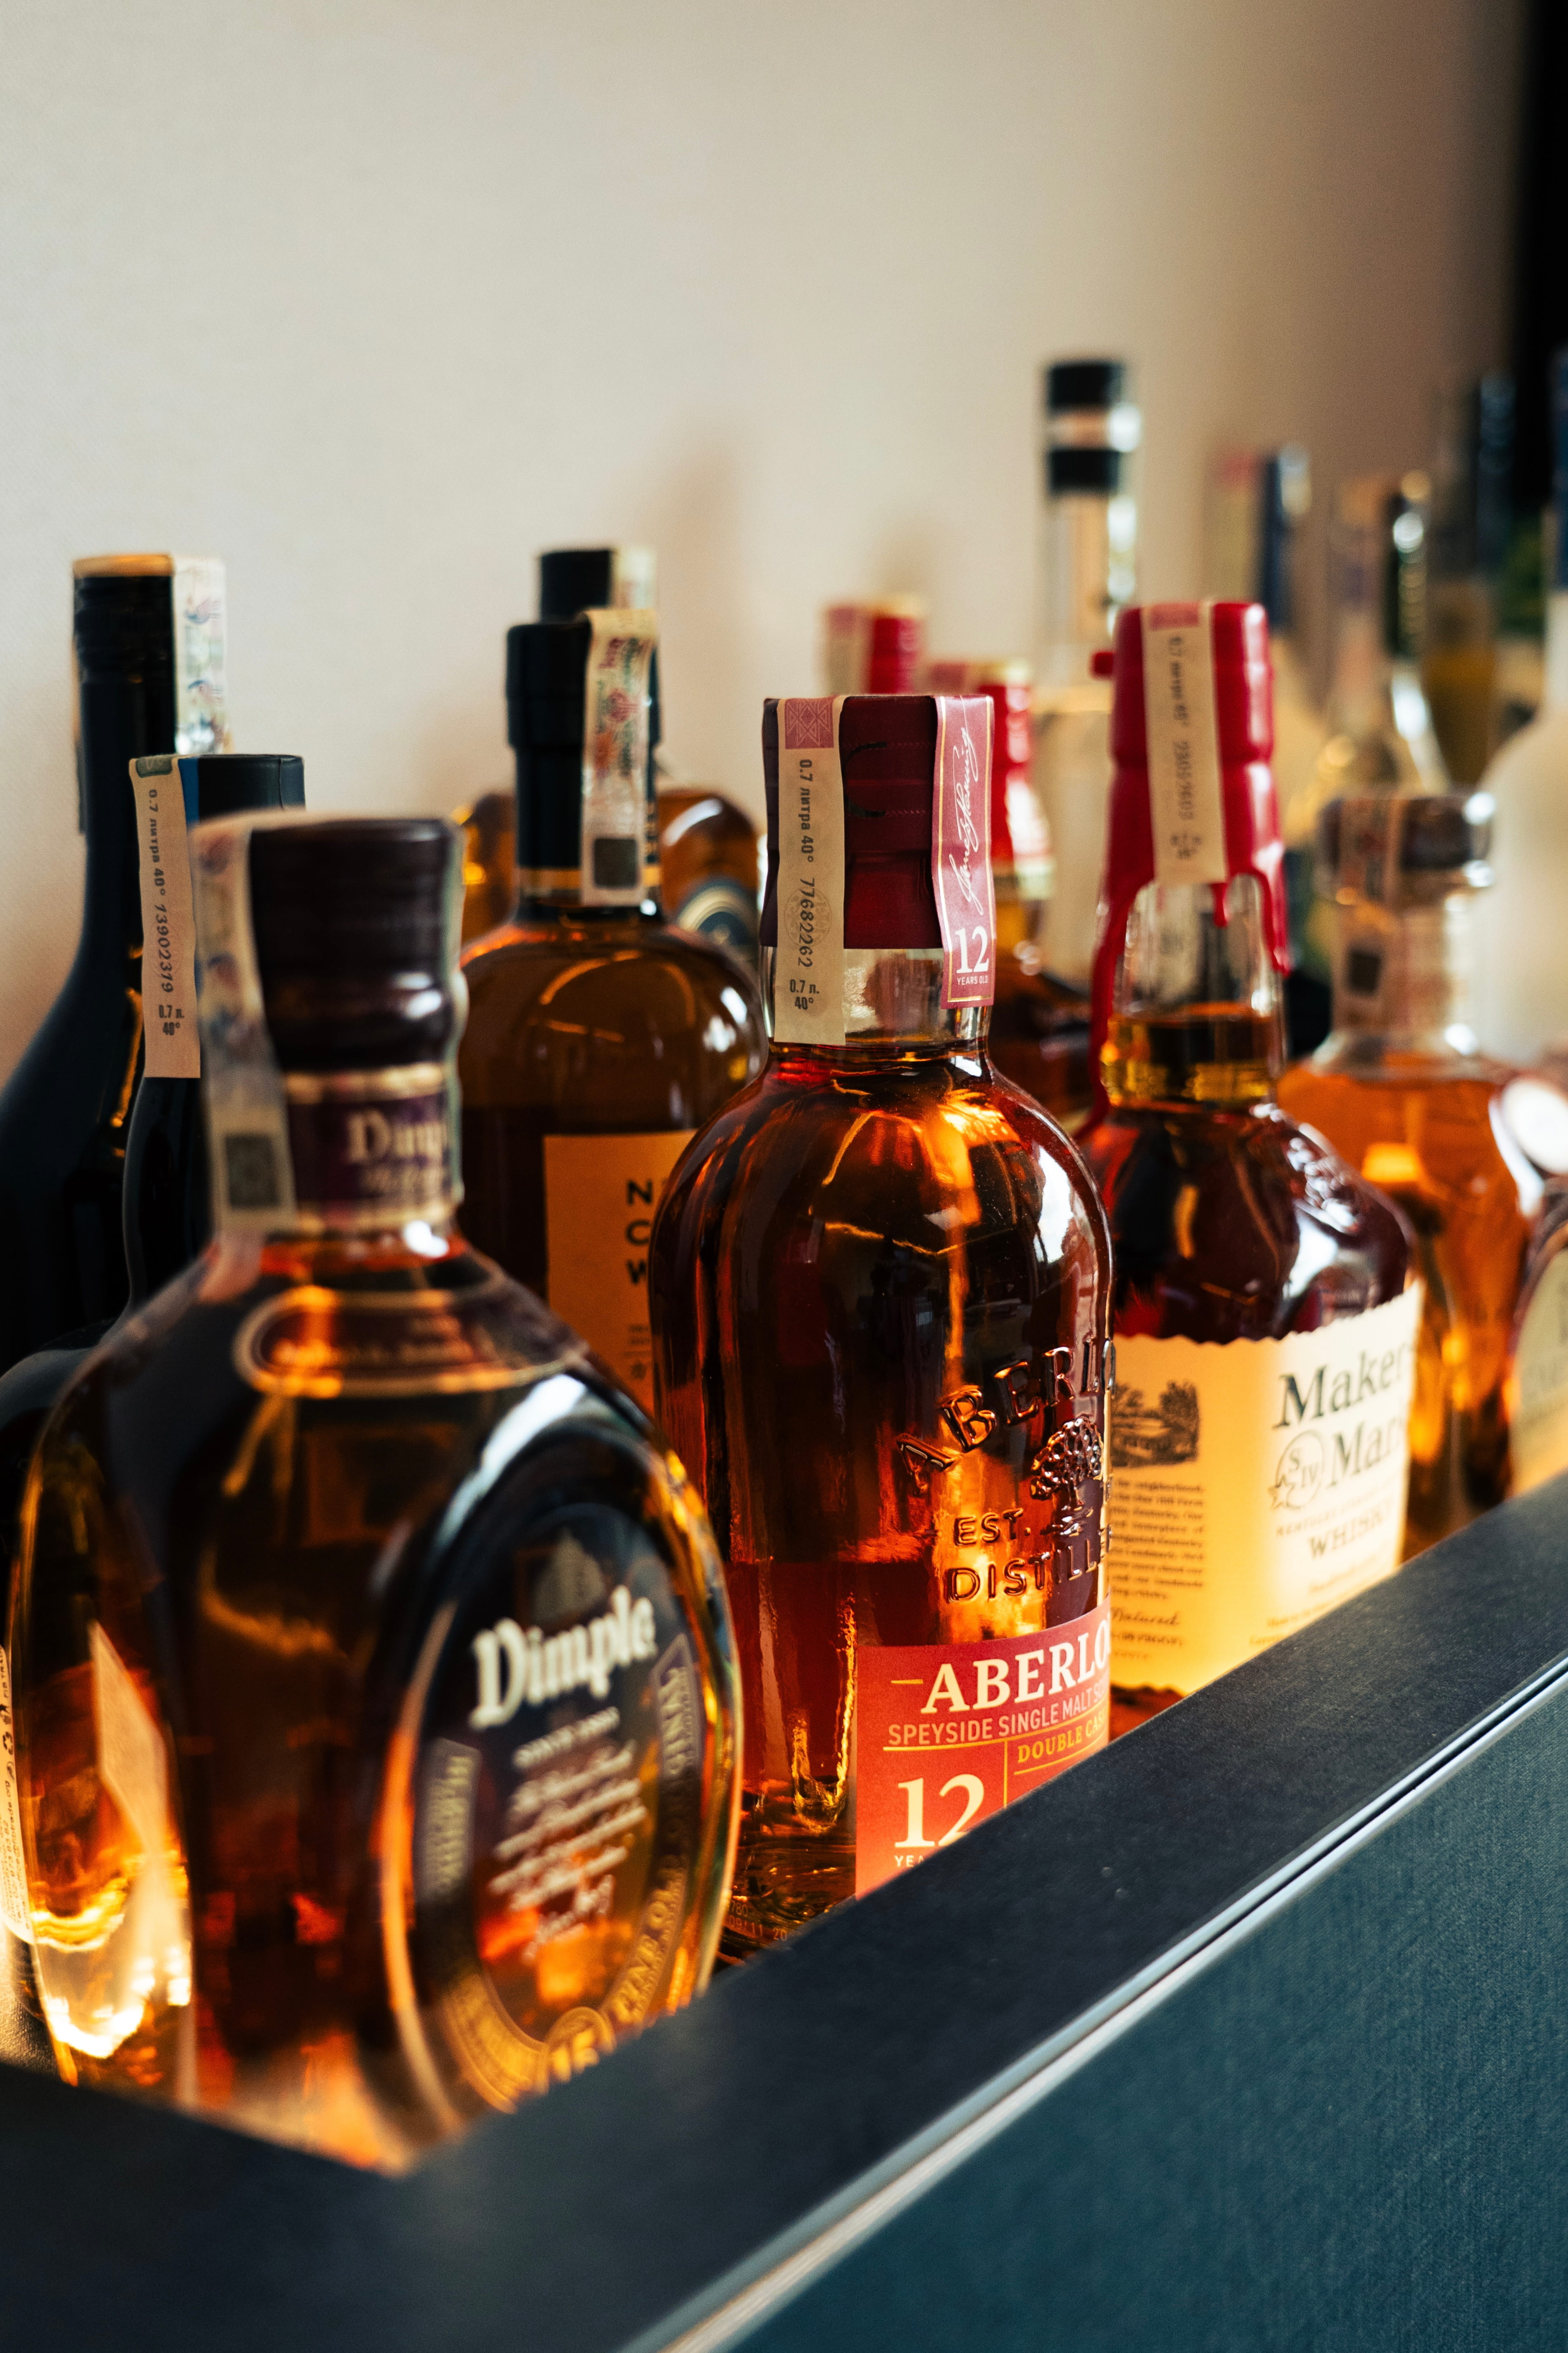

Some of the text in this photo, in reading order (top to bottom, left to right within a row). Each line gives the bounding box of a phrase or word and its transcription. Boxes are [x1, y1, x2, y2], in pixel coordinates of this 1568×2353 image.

[799, 759, 813, 782] 0.7
[149, 789, 158, 812] 0.7
[798, 787, 810, 830] литра
[150, 818, 160, 863] литра
[798, 877, 815, 968] 77682262
[955, 926, 989, 974] 12
[790, 979, 805, 993] 0.7
[956, 974, 989, 986] YEARS OLD
[1326, 1415, 1405, 1490] Mar
[953, 1508, 1030, 1547] EST.
[944, 1539, 1097, 1604] DISTILL
[469, 1584, 657, 1731] Dimple
[920, 1610, 1111, 1714] ABERLO
[888, 1718, 993, 1745] SPEYSIDE
[998, 1703, 1059, 1737] SINGLE
[1062, 1687, 1092, 1720] MALT
[1017, 1725, 1083, 1763] DOUBLE
[895, 1773, 984, 1848] 12
[895, 1855, 924, 1867] YEA
